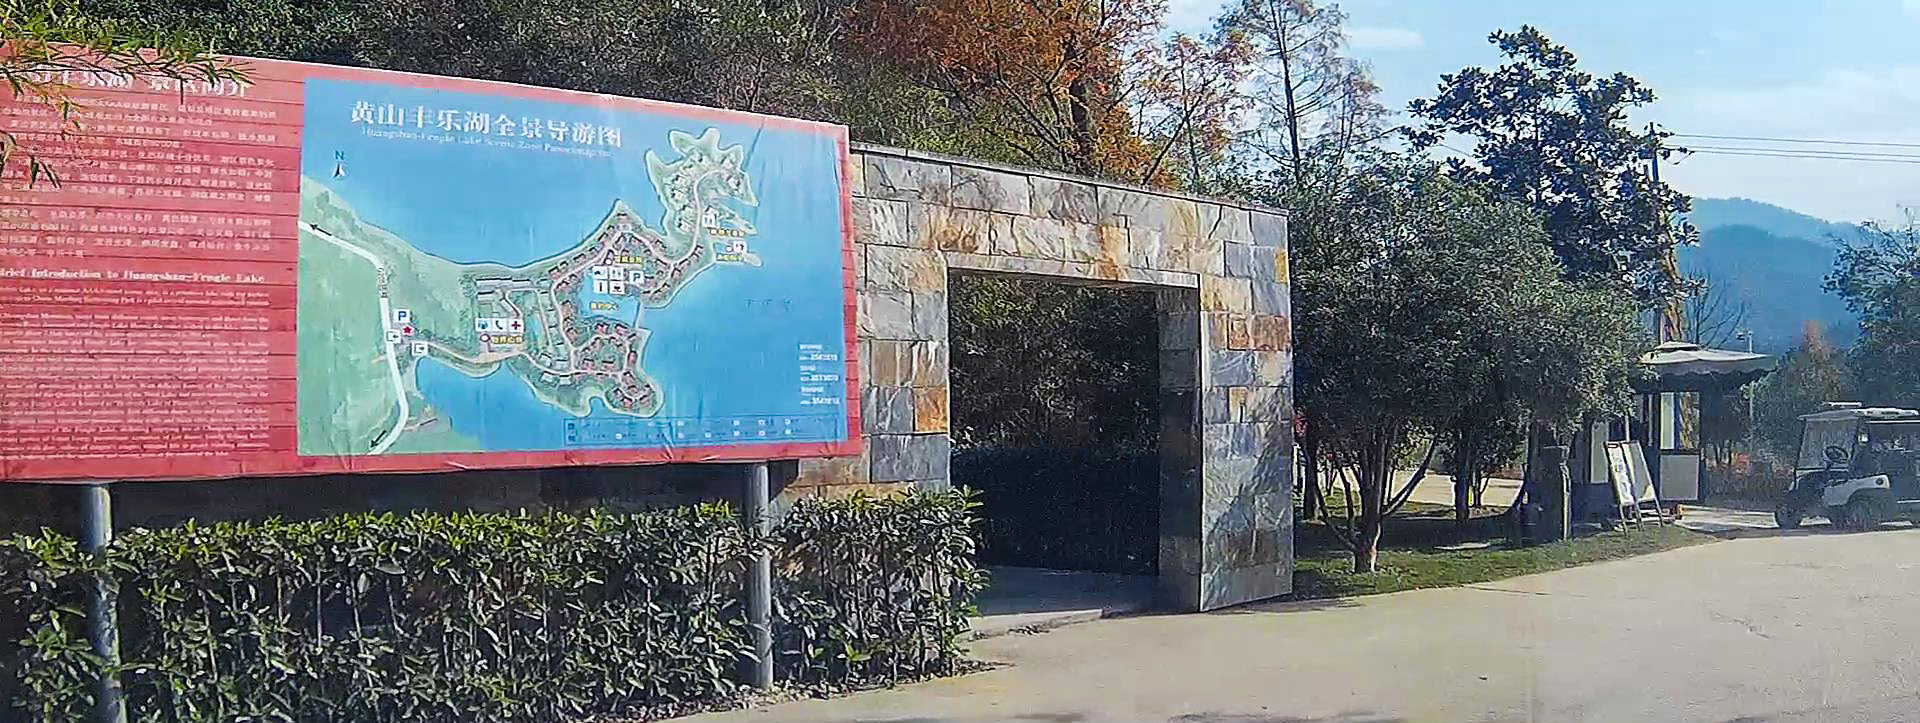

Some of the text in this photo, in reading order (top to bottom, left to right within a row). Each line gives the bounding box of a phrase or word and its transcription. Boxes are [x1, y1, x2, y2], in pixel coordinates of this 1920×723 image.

[351, 100, 622, 148] 黄山丰乐湖全景导游图
[334, 151, 344, 160] N
[31, 269, 101, 279] Introduction
[107, 270, 119, 279] to
[236, 273, 265, 284] Lake
[633, 272, 641, 281] P
[398, 311, 407, 320] P
